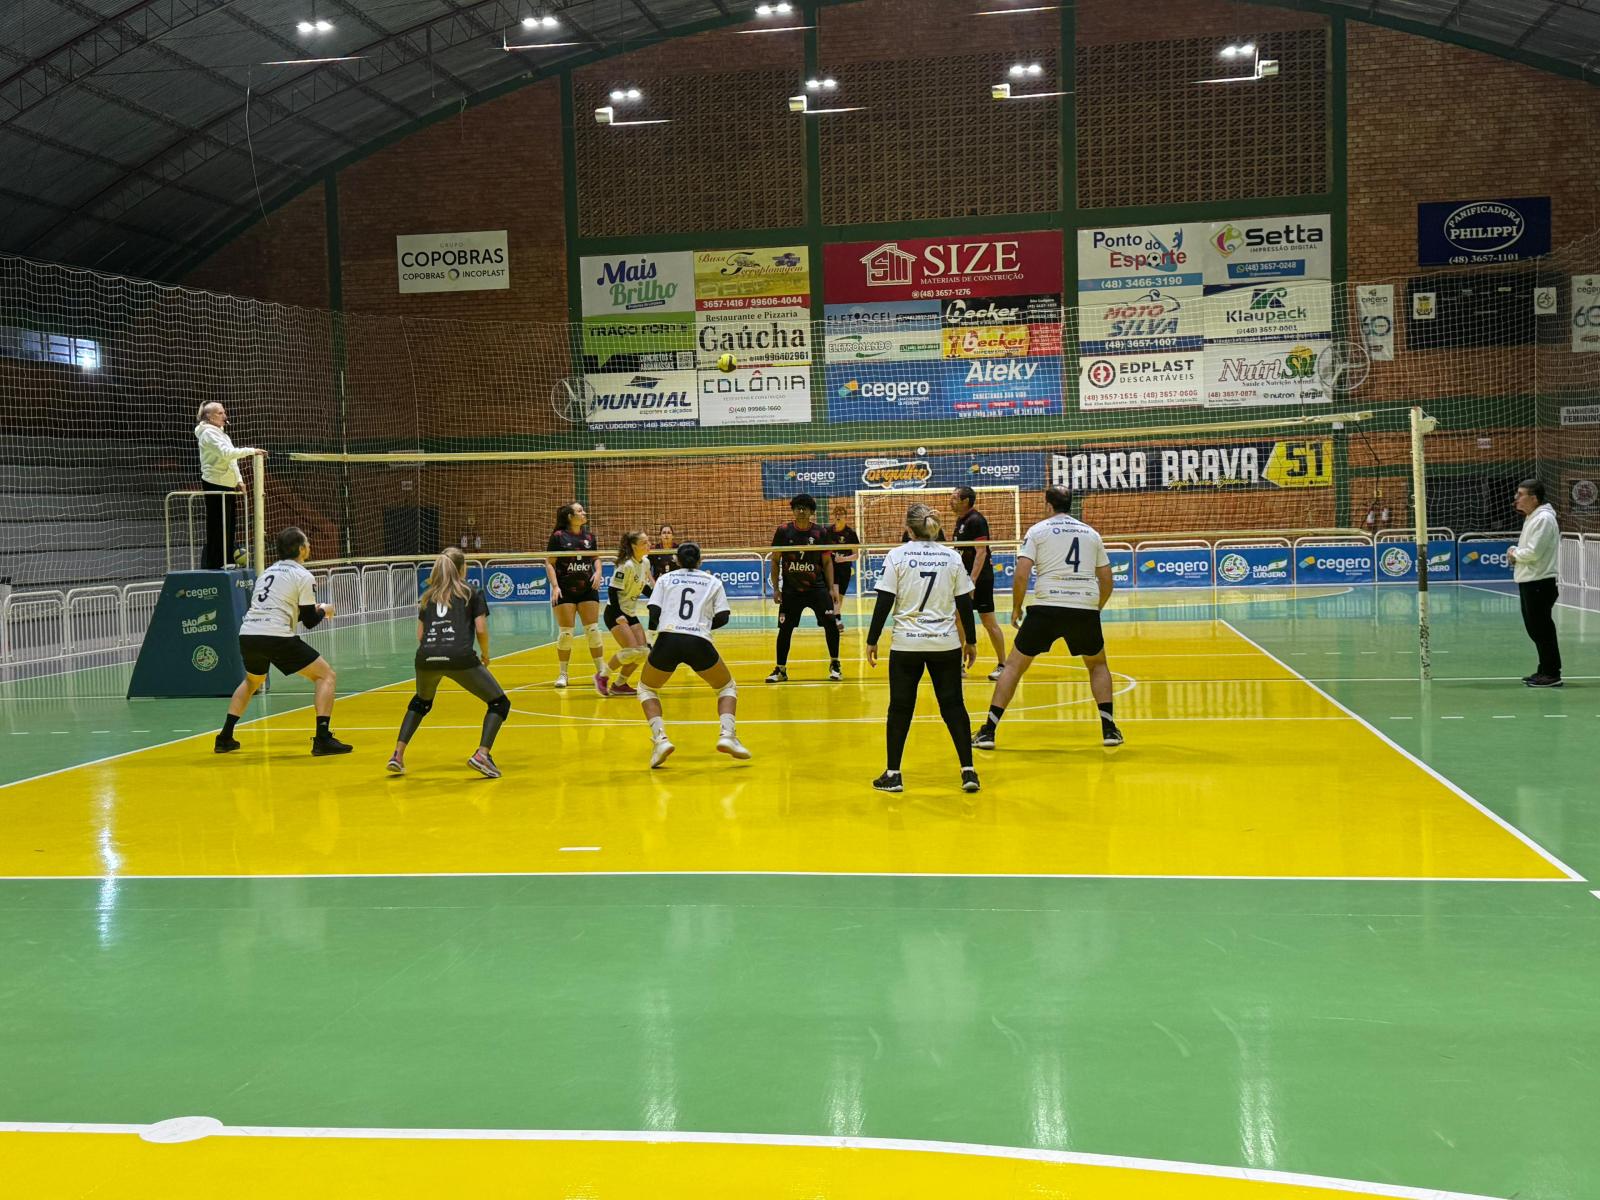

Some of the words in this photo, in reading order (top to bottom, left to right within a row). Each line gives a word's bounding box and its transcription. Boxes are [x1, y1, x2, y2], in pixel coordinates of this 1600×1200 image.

[1448, 205, 1520, 228] PANIFICADORA
[1093, 231, 1142, 249] Ponto
[1245, 224, 1323, 247] Setta
[1450, 226, 1518, 240] PHILIPPI
[1145, 240, 1160, 251] do
[1250, 245, 1288, 253] IMPRESSÃO
[1290, 244, 1318, 252] DIGITAL
[401, 248, 504, 267] COPOBRAS
[923, 241, 1021, 276] SIZE
[1109, 248, 1187, 270] Esporte
[1449, 255, 1469, 264] (48)
[1471, 253, 1518, 263] 3657-1101
[597, 258, 657, 286] Mais
[1245, 263, 1259, 272] (48)
[1260, 261, 1297, 270] 3657-0248
[402, 271, 445, 281] COPOBRAS
[462, 269, 505, 278] INCOPLAST
[920, 277, 960, 285] MATERIAIS
[973, 272, 1024, 281] CONSTRUÇÃO
[1101, 280, 1122, 290] (48)
[1577, 286, 1600, 295] ceger
[610, 280, 678, 306] Brilho
[920, 290, 934, 298] (48)
[936, 288, 971, 297] 3657-1276
[703, 299, 744, 308] 3657-1416
[751, 296, 803, 306] 99606-4044
[1361, 296, 1388, 305] cegero
[706, 313, 754, 322] Restaurante
[764, 311, 798, 320] Pizzaria
[1226, 307, 1307, 325] Klaupack
[588, 324, 637, 338] TRAÇO
[642, 324, 688, 335] FORTE
[1108, 317, 1180, 337] SILVA
[699, 323, 807, 352] Gaúcha
[962, 330, 1026, 352] becker
[829, 341, 892, 353] ELETRONANDO
[1105, 341, 1125, 350] (48)
[965, 360, 1039, 383] Ateky
[1119, 359, 1194, 374] EDPLAST
[704, 370, 806, 393] COLÔNIA
[1120, 373, 1194, 384] DESCARTÁVEIS
[1265, 379, 1291, 387] Nutrição
[861, 381, 930, 402] cegero
[590, 391, 692, 411] MUNDIAL
[980, 463, 1020, 477] cegero
[1052, 451, 1147, 488] BARRA
[1161, 447, 1259, 487] BRAVA
[1285, 441, 1325, 478] 51
[796, 470, 835, 484] cegero
[1065, 537, 1081, 573] 4
[1480, 553, 1509, 568] ceg
[1157, 560, 1209, 576] cegero
[1252, 564, 1268, 572] SÃO
[1316, 557, 1371, 573] cegero
[713, 571, 760, 585] cegero
[185, 587, 218, 598] cegero
[258, 575, 275, 602] 3
[517, 582, 531, 590] SÃO
[919, 571, 938, 612] 7
[678, 587, 696, 620] 6
[182, 617, 197, 627] SÃO
[183, 624, 218, 635] LUDGERO
